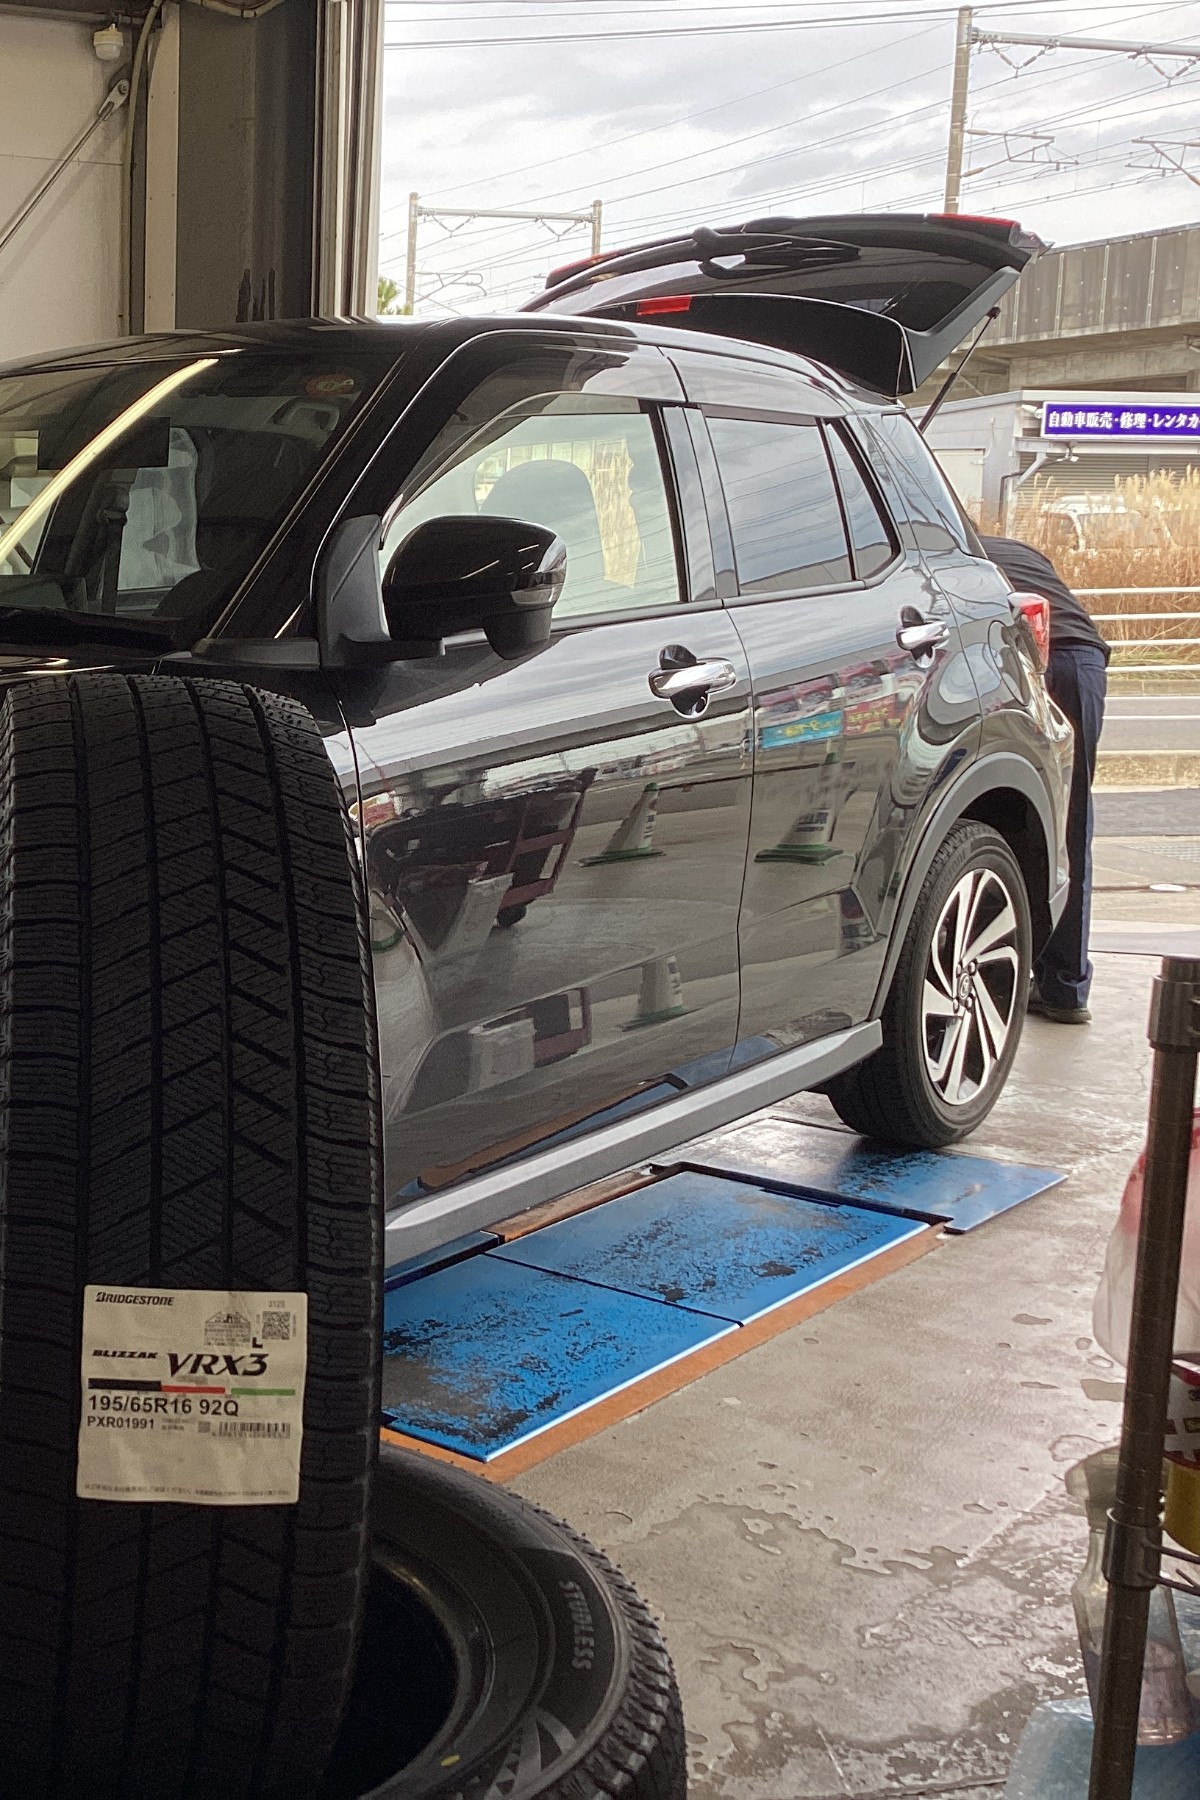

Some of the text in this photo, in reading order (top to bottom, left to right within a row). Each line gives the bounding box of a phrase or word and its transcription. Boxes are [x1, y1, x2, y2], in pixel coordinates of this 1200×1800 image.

[95, 1291, 175, 1306] BRIDGESTONE
[92, 1349, 269, 1377] BLIZZAK VRX3
[88, 1395, 239, 1417] 195/65R16 92Q
[87, 1415, 155, 1430] PXR01991
